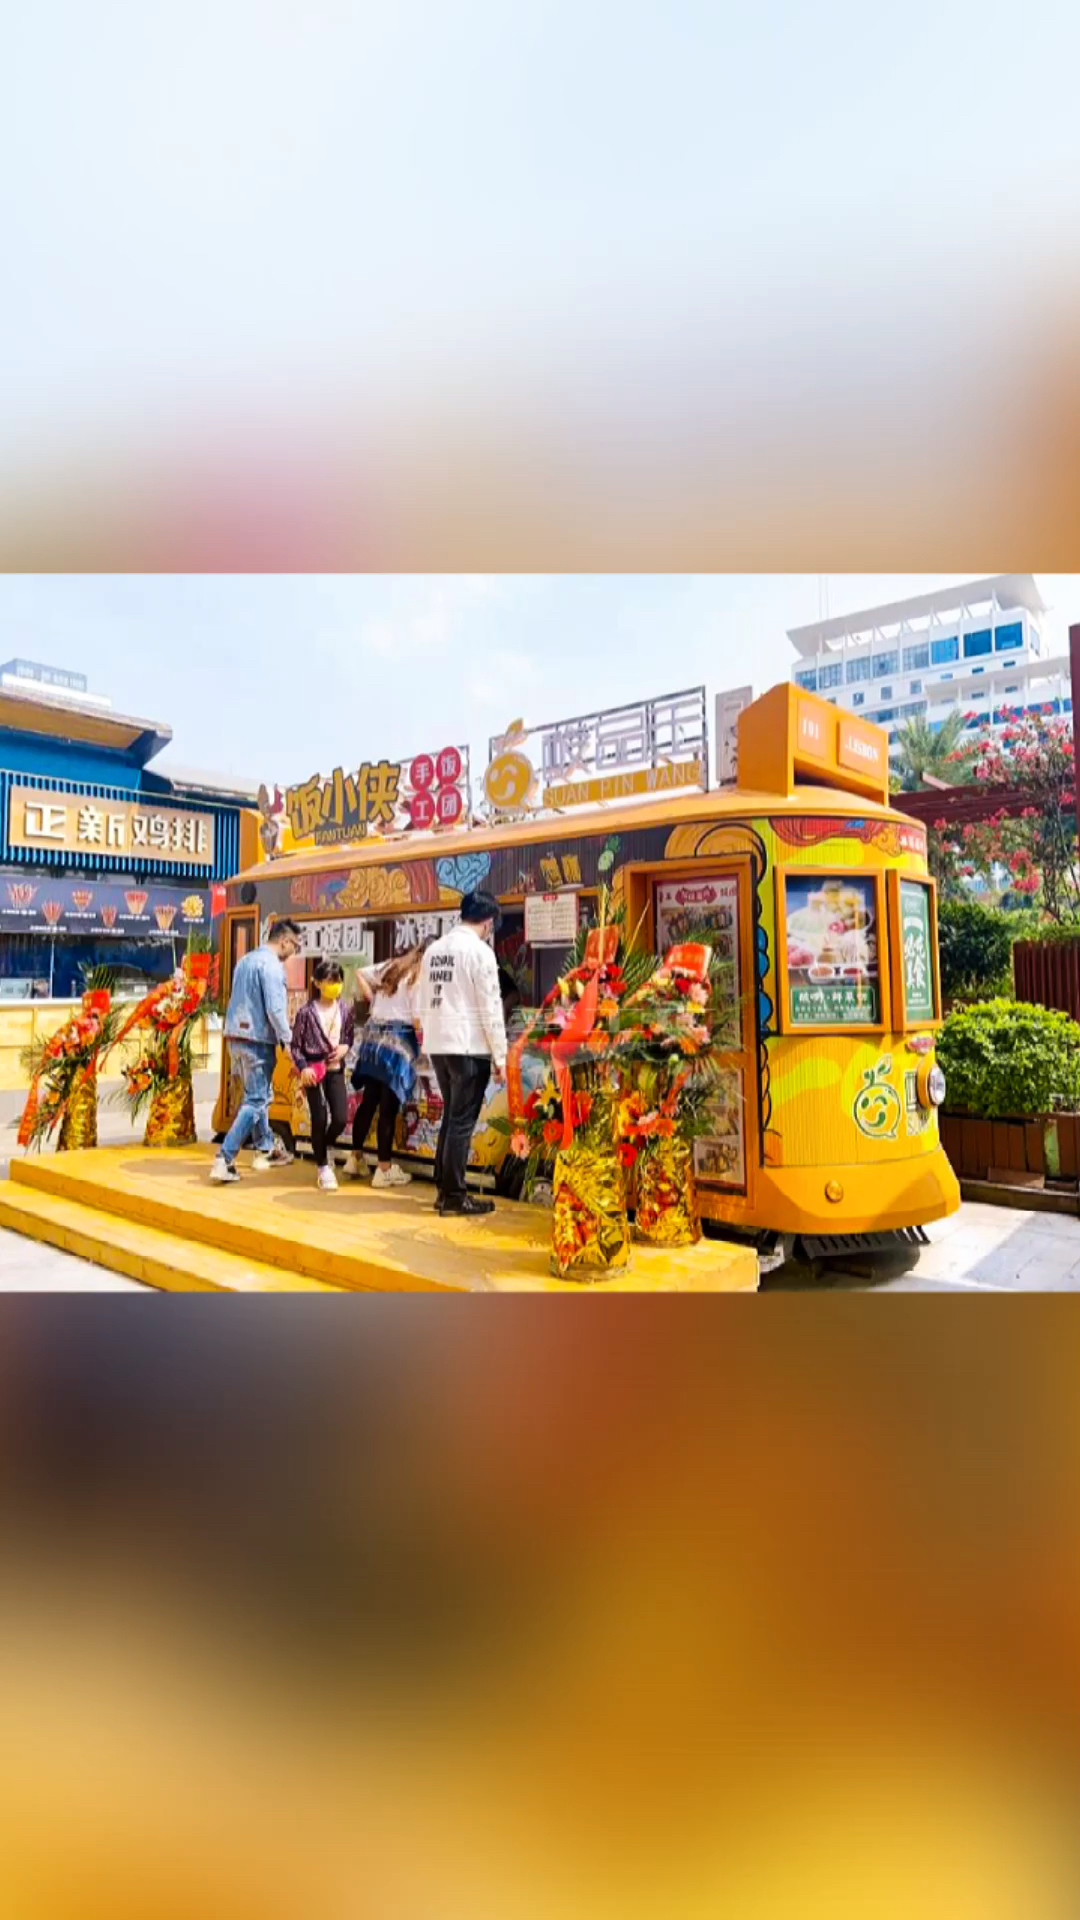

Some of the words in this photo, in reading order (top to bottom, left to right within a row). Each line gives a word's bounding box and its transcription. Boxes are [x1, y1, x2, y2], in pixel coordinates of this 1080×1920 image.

[287, 760, 400, 839] 饭小侠
[600, 773, 634, 799] PIN
[24, 800, 208, 853] 正新鸡排
[315, 825, 367, 845] FANTUAN
